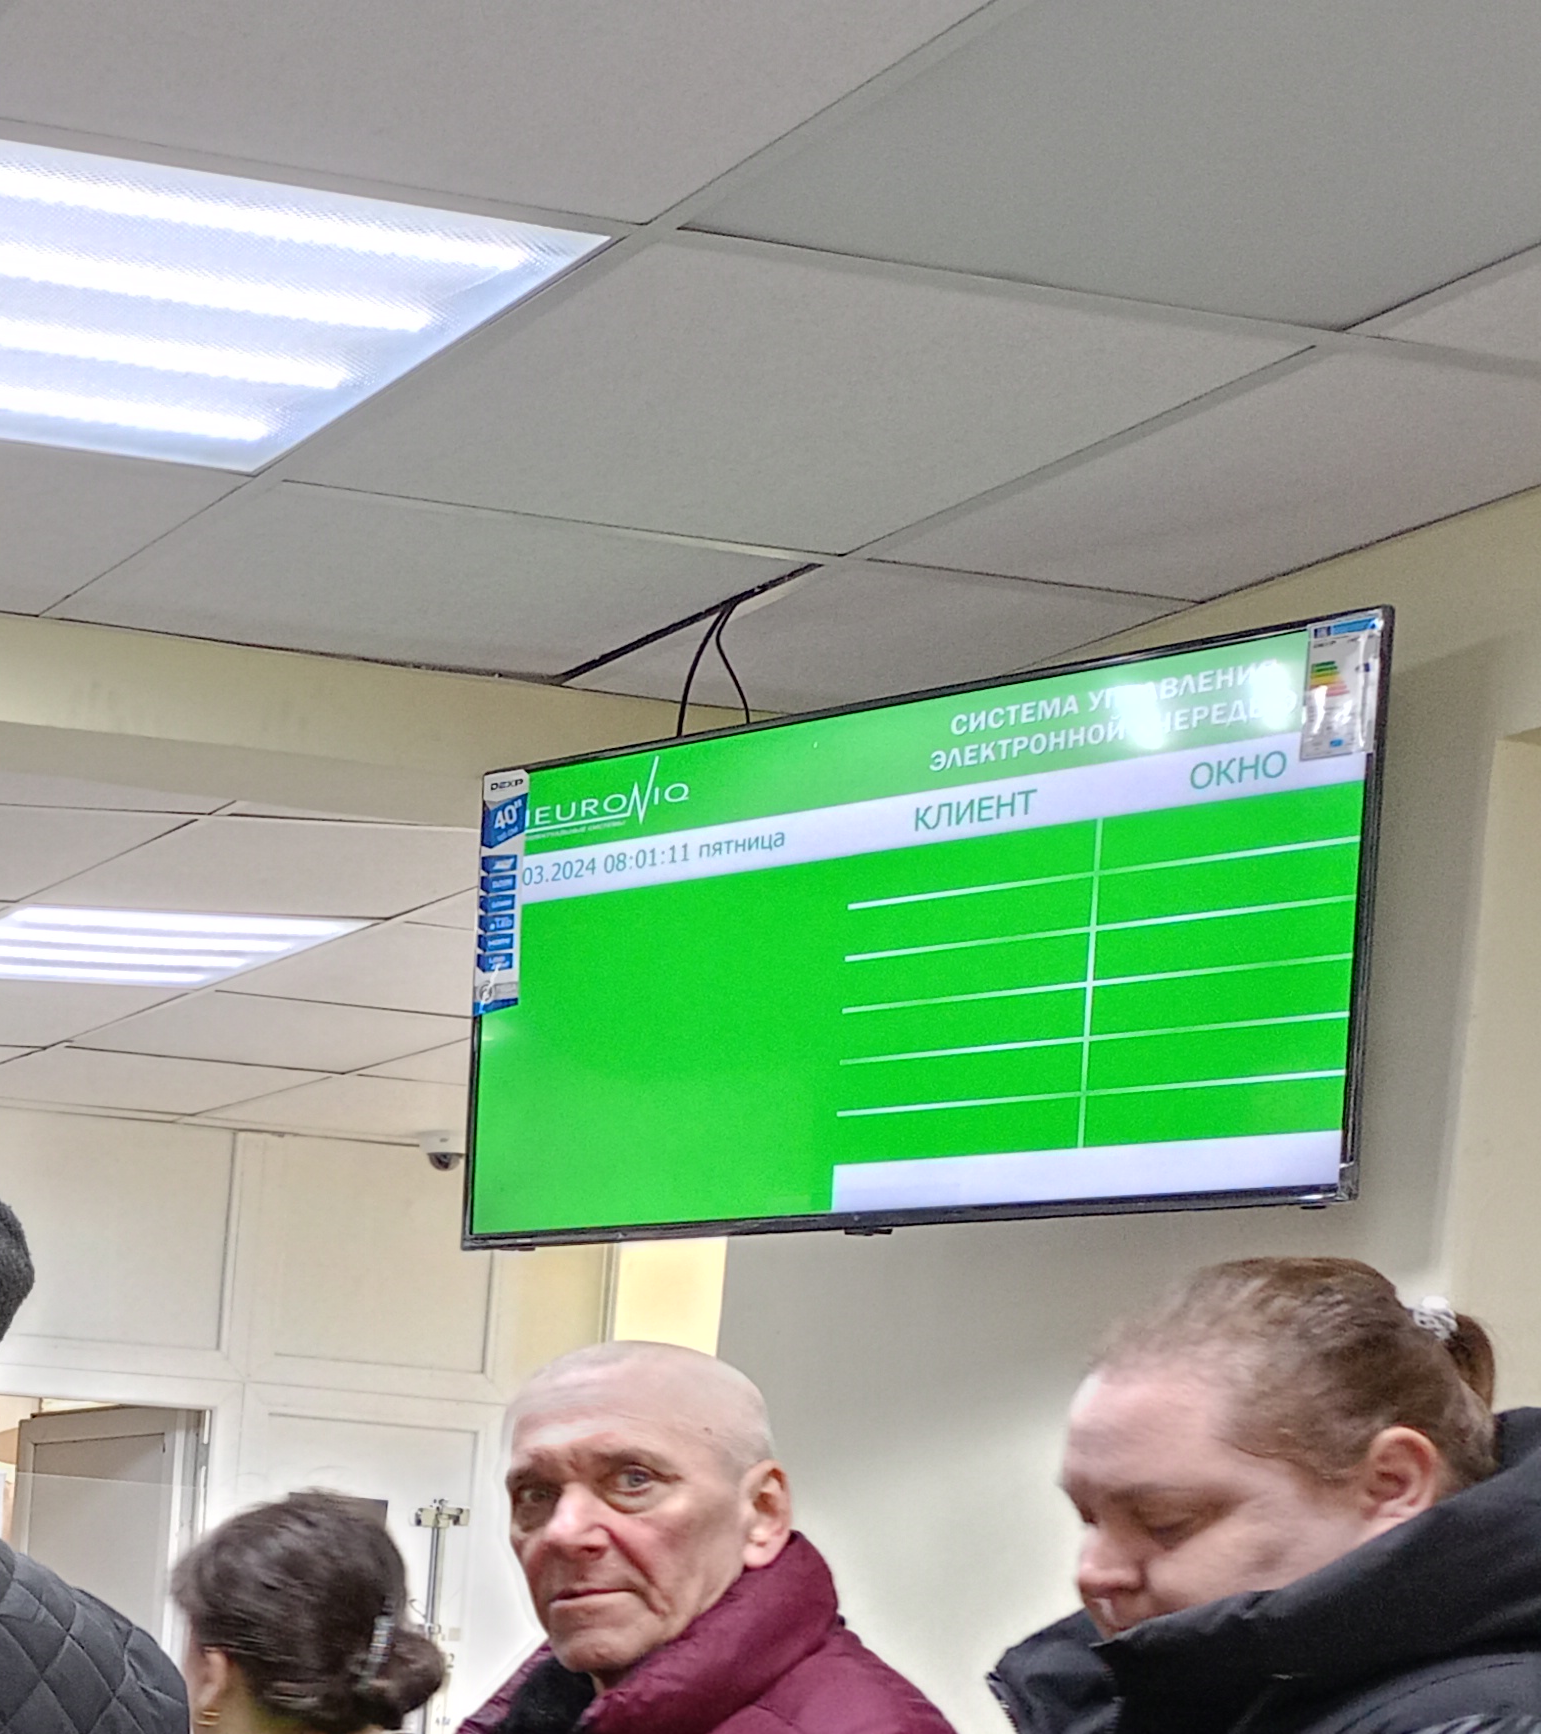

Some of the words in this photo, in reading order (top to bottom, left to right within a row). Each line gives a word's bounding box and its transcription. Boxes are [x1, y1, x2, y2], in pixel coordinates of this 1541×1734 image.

[951, 695, 1079, 736] СИСТЕМА
[929, 714, 1125, 772] ЭЛЕКТРОННОЙ
[1190, 750, 1287, 790] ОКНО
[494, 799, 523, 829] 40"
[914, 789, 1038, 832] КЛИЕНТ
[604, 843, 689, 874] 08:01:11
[699, 832, 786, 859] пятница
